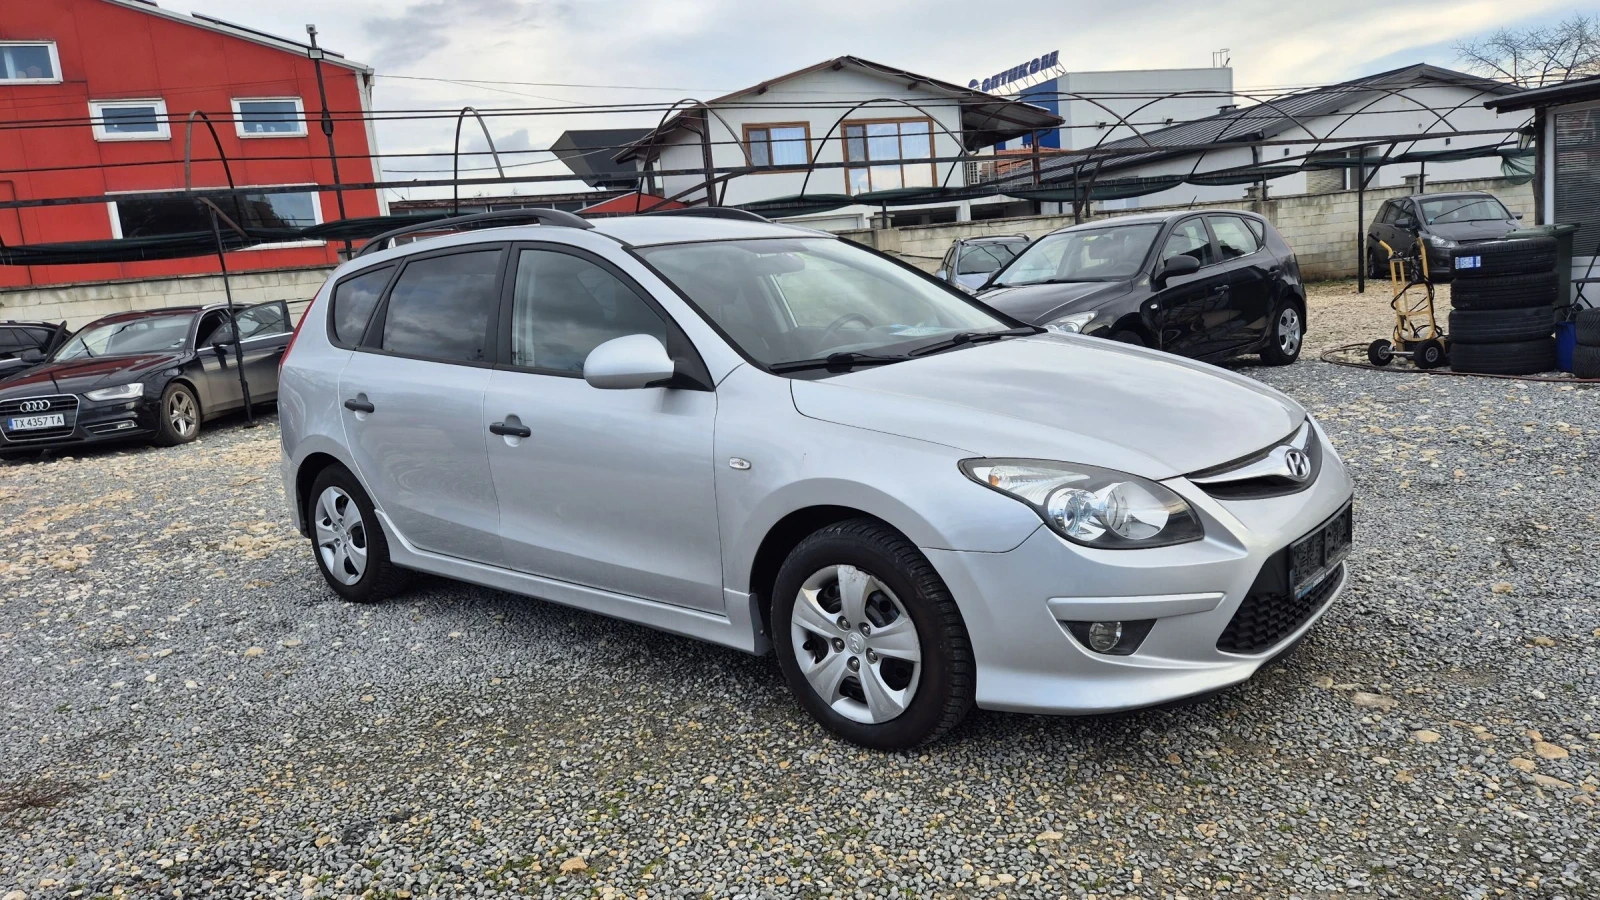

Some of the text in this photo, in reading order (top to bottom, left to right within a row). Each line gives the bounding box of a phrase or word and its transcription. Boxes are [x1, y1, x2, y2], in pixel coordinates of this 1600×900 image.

[14, 415, 63, 428] TX 4357 TA
